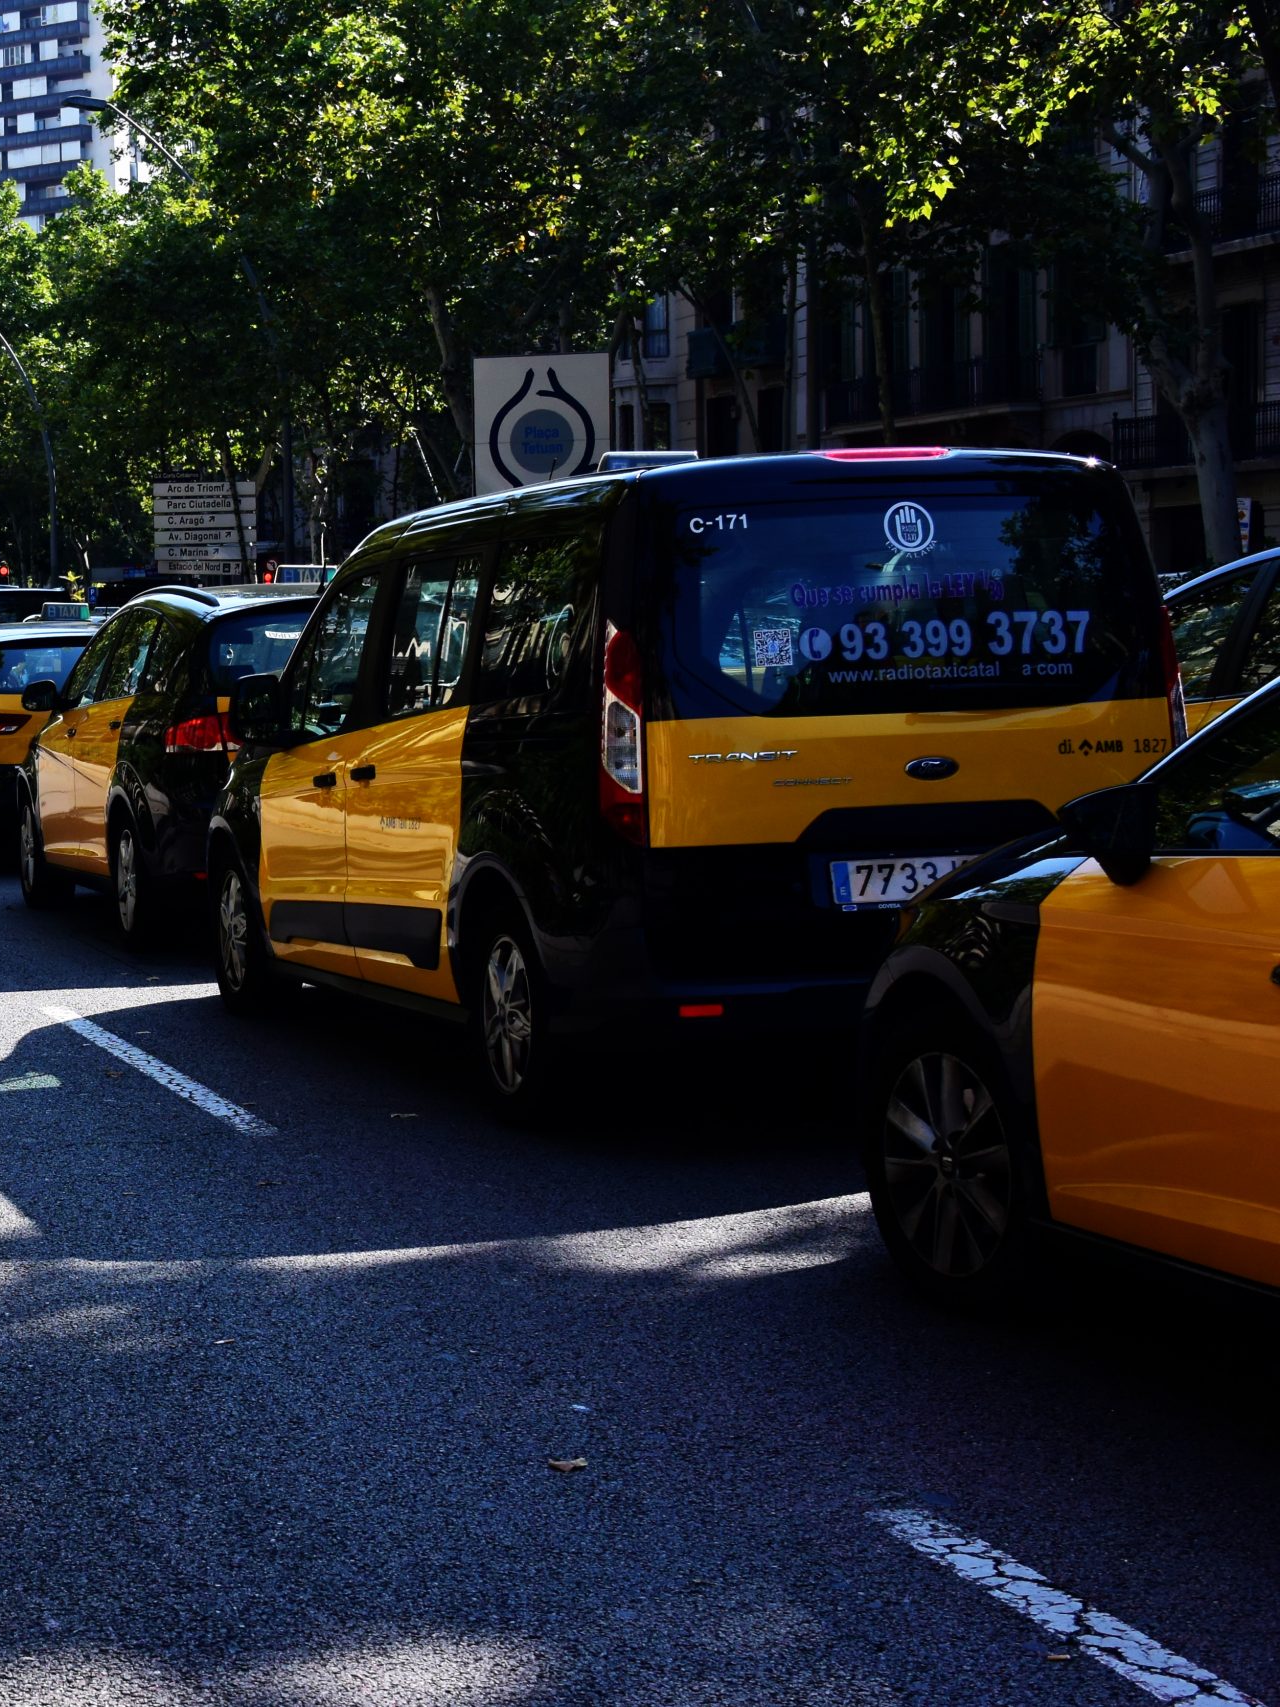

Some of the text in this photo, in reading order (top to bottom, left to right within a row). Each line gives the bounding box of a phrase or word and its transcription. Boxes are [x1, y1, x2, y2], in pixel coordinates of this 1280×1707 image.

[524, 426, 560, 441] Plaça
[521, 442, 564, 455] Tetuan
[167, 483, 225, 493] Arc de Triomf
[167, 499, 231, 509] Parc Ciutadella
[167, 516, 205, 526] C. Aragó
[689, 513, 748, 534] C-171
[168, 531, 221, 542] Av. Diagonal
[903, 533, 917, 541] TAXI
[168, 548, 209, 557] C. Marina
[168, 562, 221, 571] Estació del Nord
[297, 569, 321, 583] TAX
[791, 582, 830, 608] Que
[833, 583, 854, 604] se
[859, 575, 921, 608] cumpla
[923, 572, 943, 599] la
[943, 572, 976, 598] LEY
[60, 605, 79, 617] TAXI
[839, 610, 1090, 661] 93 399 3737
[1096, 740, 1124, 753] AMB
[1133, 738, 1168, 753] 1827
[688, 749, 798, 765] TRANSIT
[773, 776, 854, 787] CONNECT
[855, 861, 938, 897] 7733
